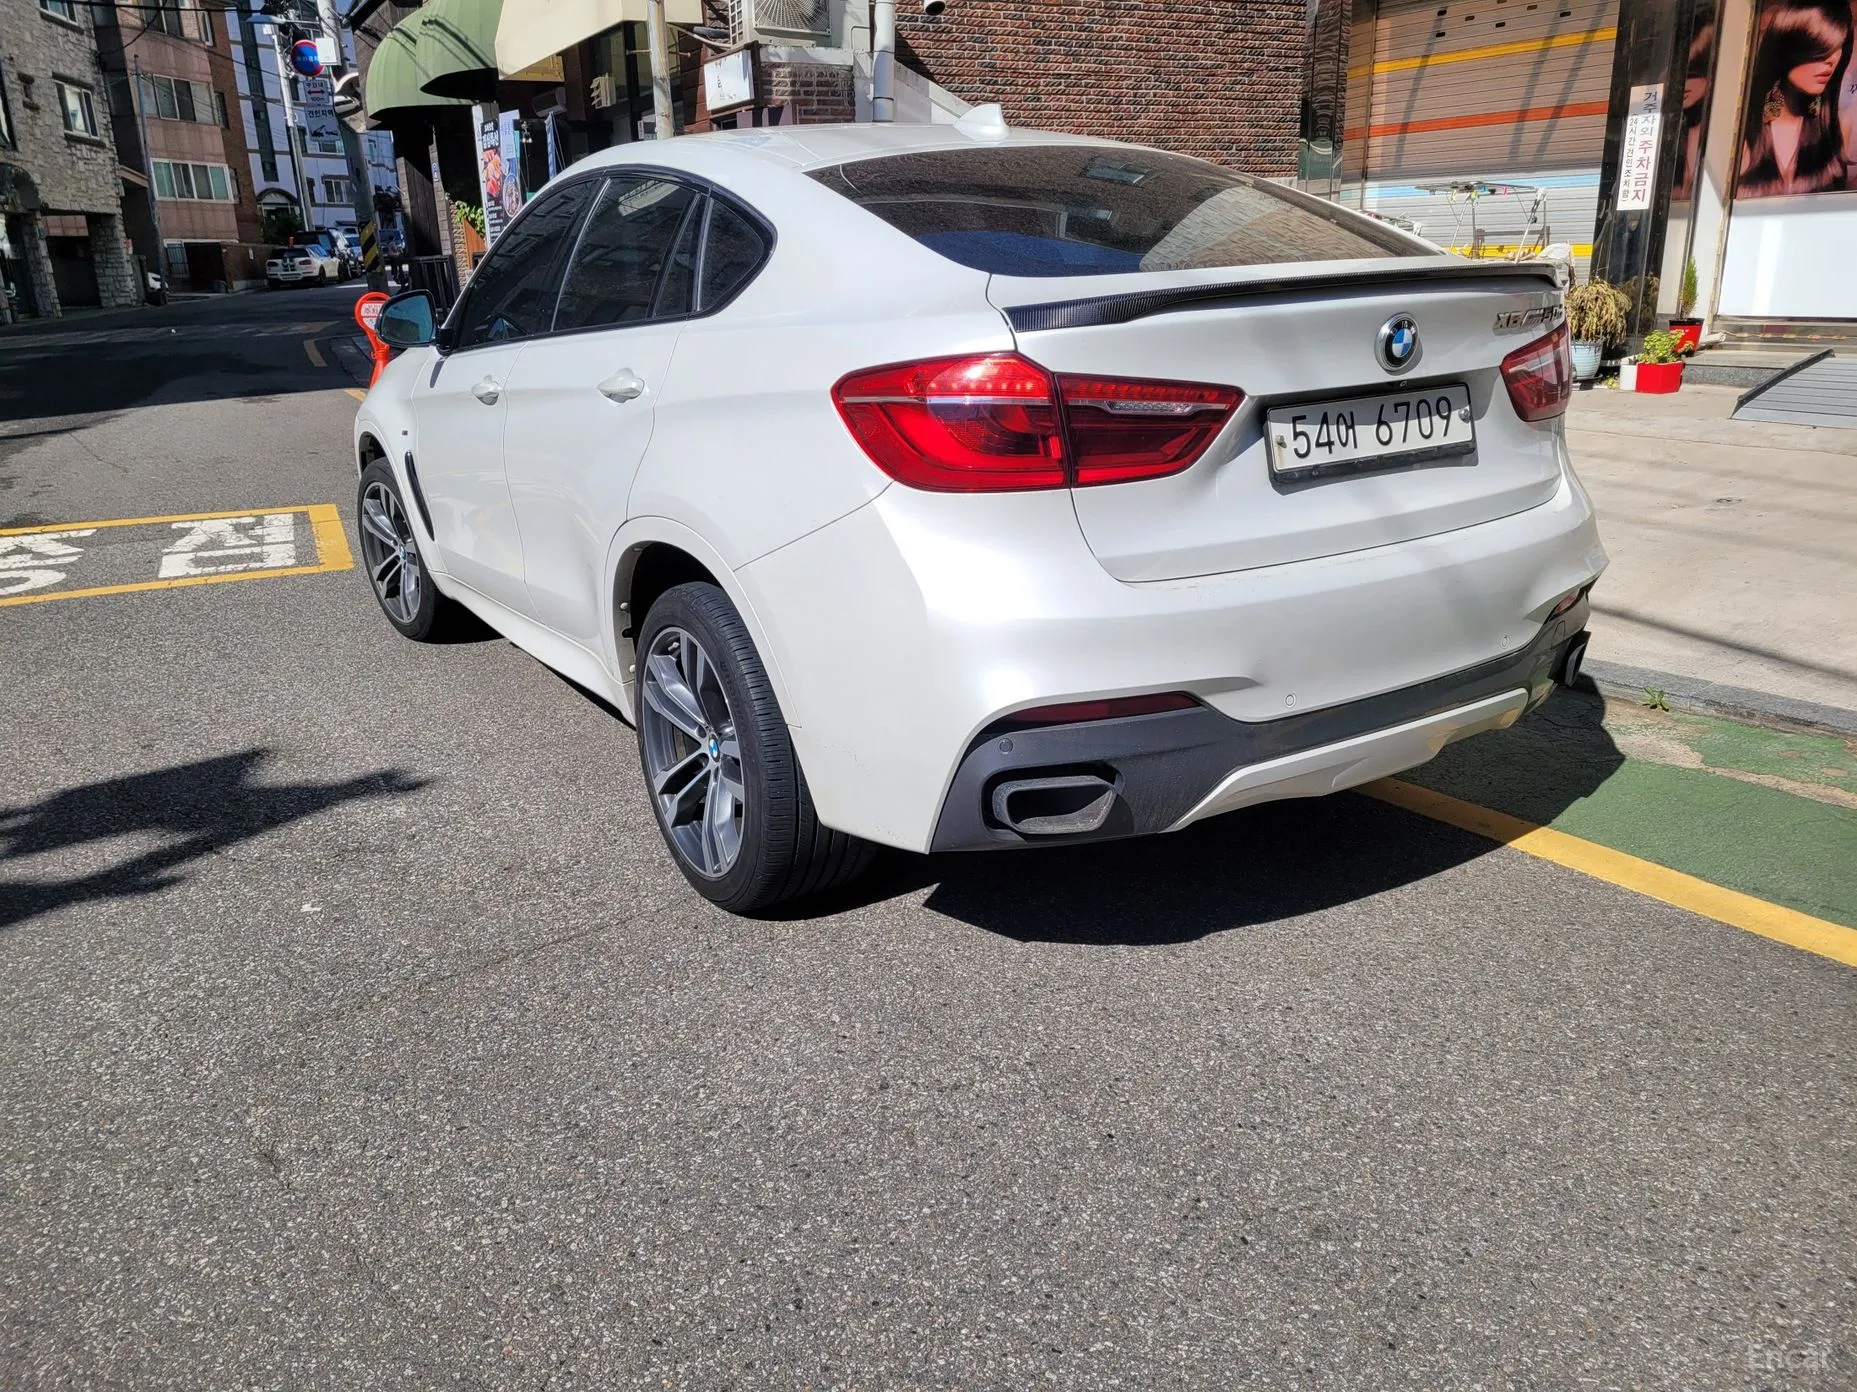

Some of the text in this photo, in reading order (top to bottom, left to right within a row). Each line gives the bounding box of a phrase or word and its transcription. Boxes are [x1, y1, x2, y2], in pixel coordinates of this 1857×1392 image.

[307, 109, 334, 118] 견인지역
[1631, 140, 1653, 202] 주차금지
[1291, 396, 1452, 459] 54어 6709
